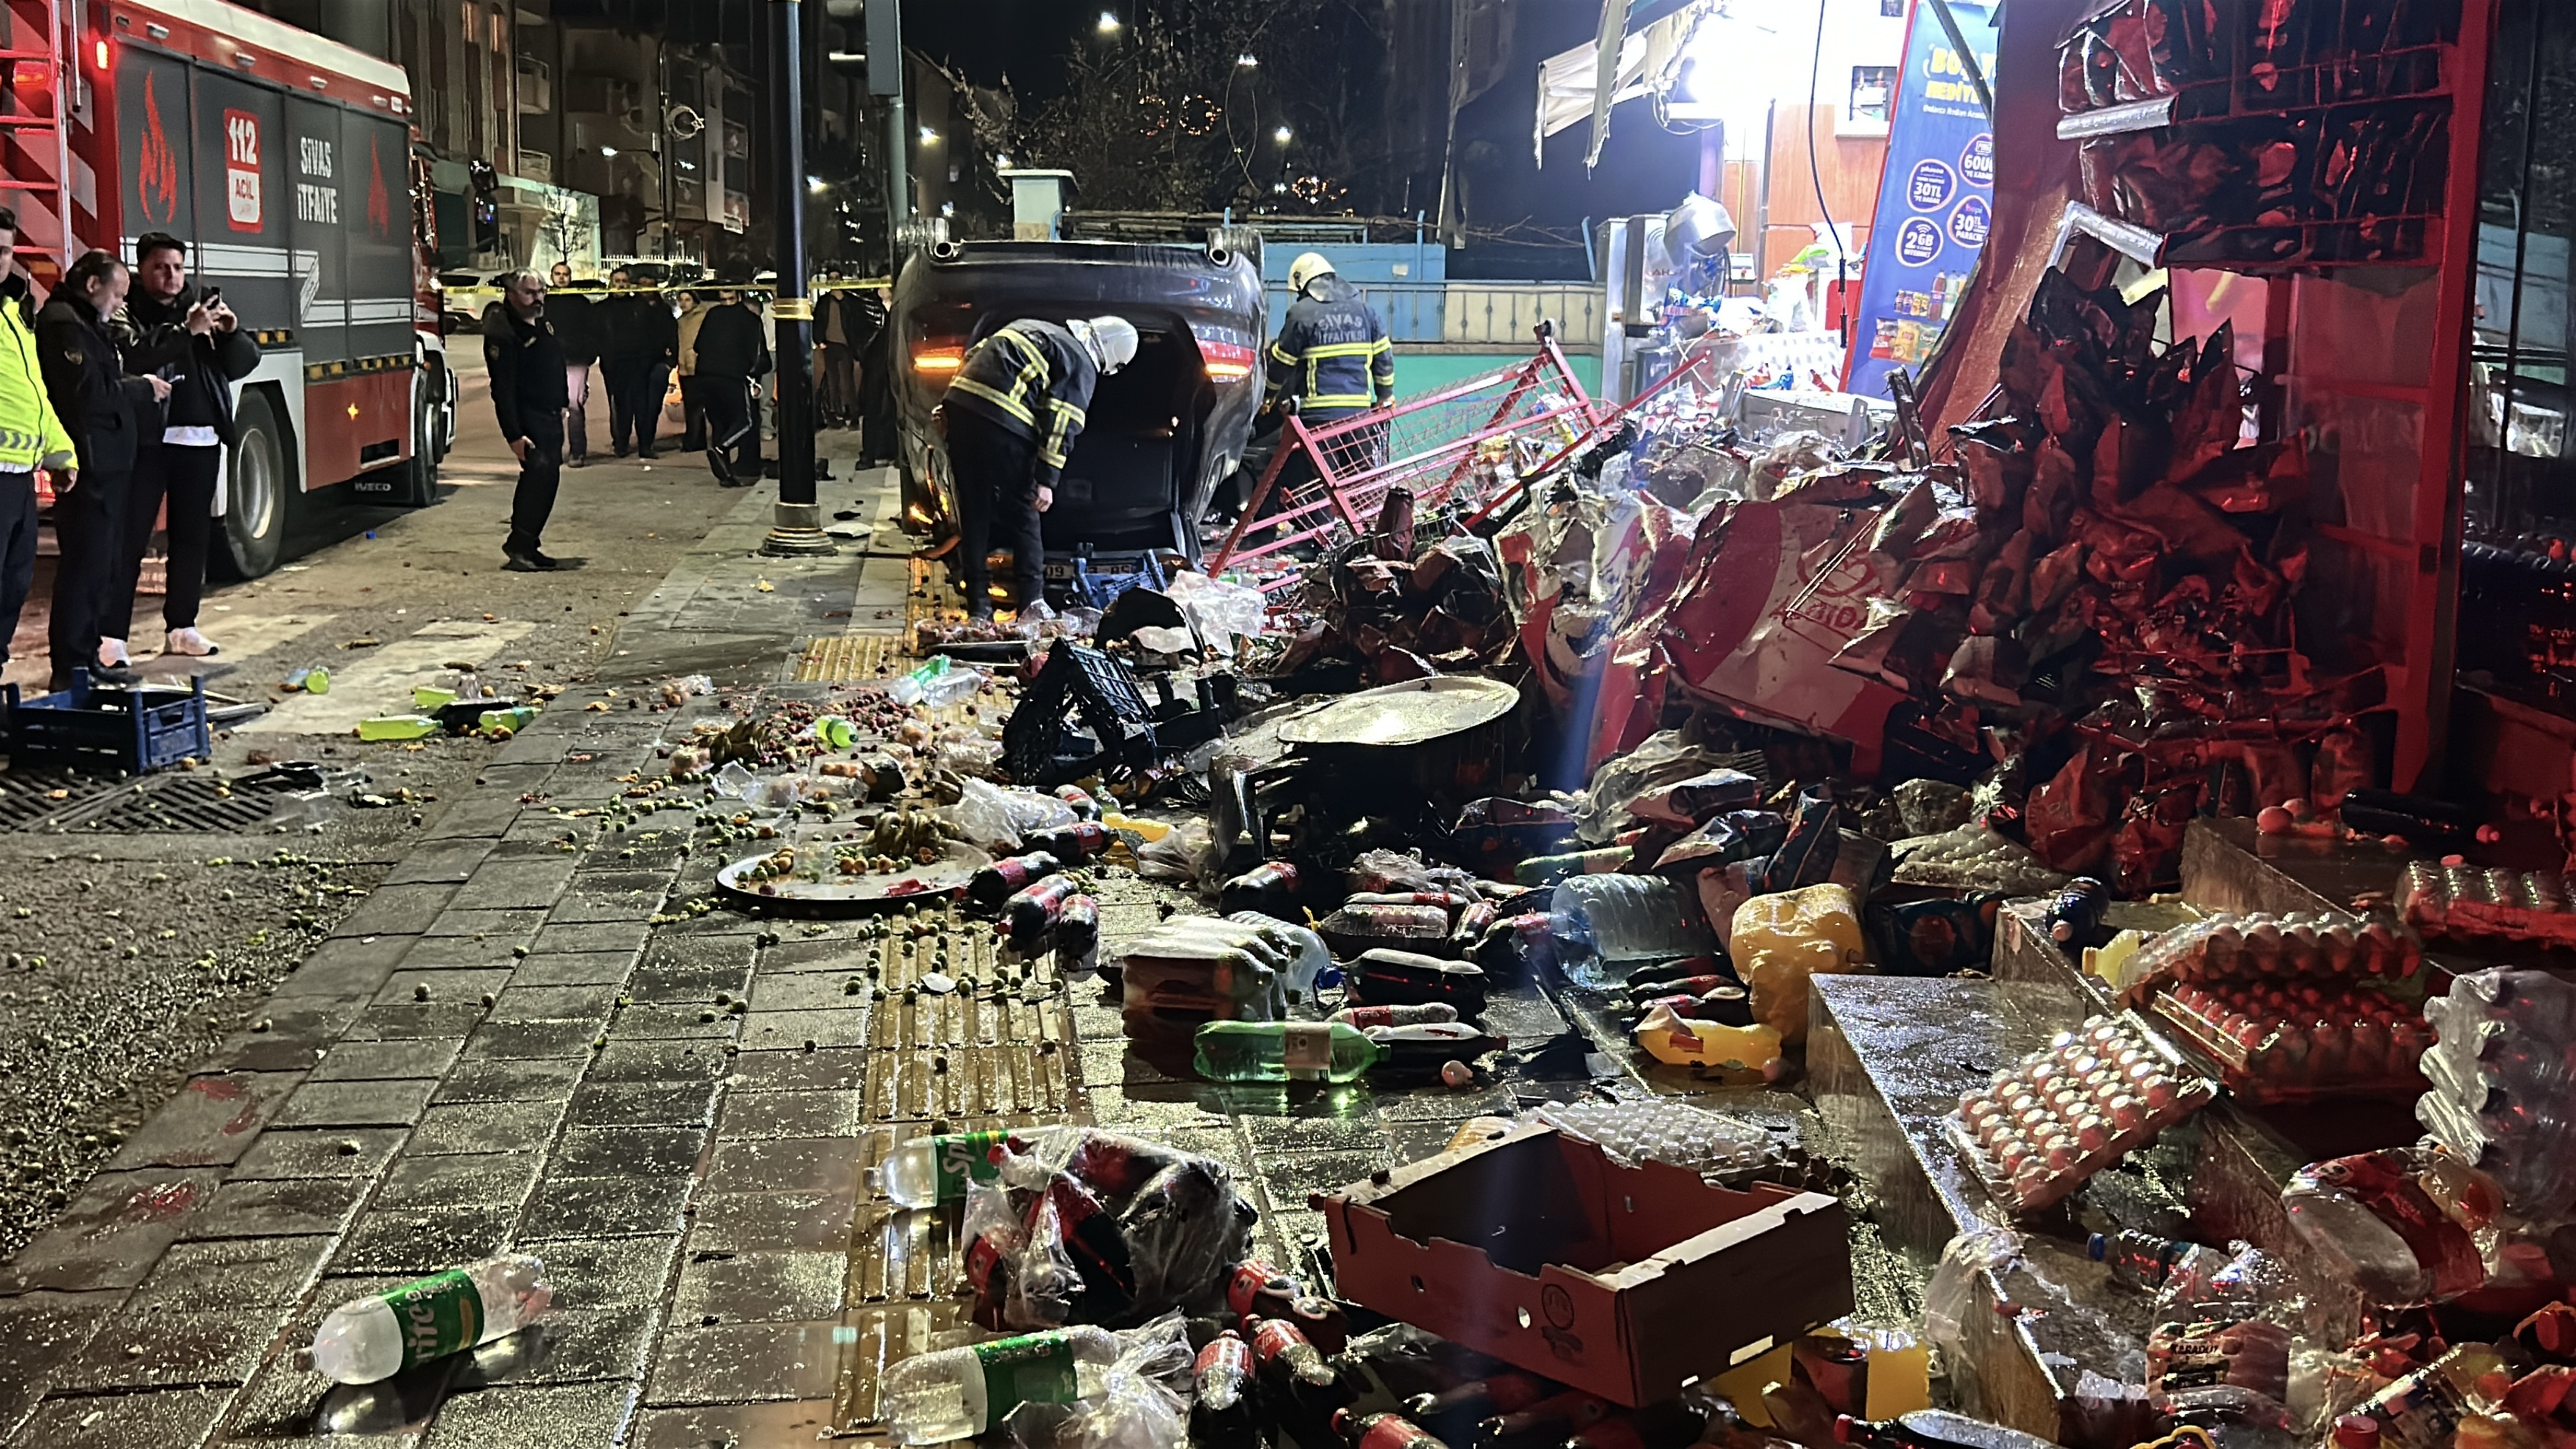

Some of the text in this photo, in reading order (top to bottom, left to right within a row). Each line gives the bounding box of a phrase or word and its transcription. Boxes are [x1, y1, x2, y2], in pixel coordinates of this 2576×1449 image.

[228, 116, 257, 165] 112
[235, 175, 254, 201] ACİL
[1913, 182, 1942, 198] 30TL
[297, 183, 337, 224] İTFAİYE
[1955, 214, 1974, 231] 30
[1905, 231, 1917, 249] 2
[1917, 233, 1934, 247] GB
[354, 482, 392, 491] IVECO
